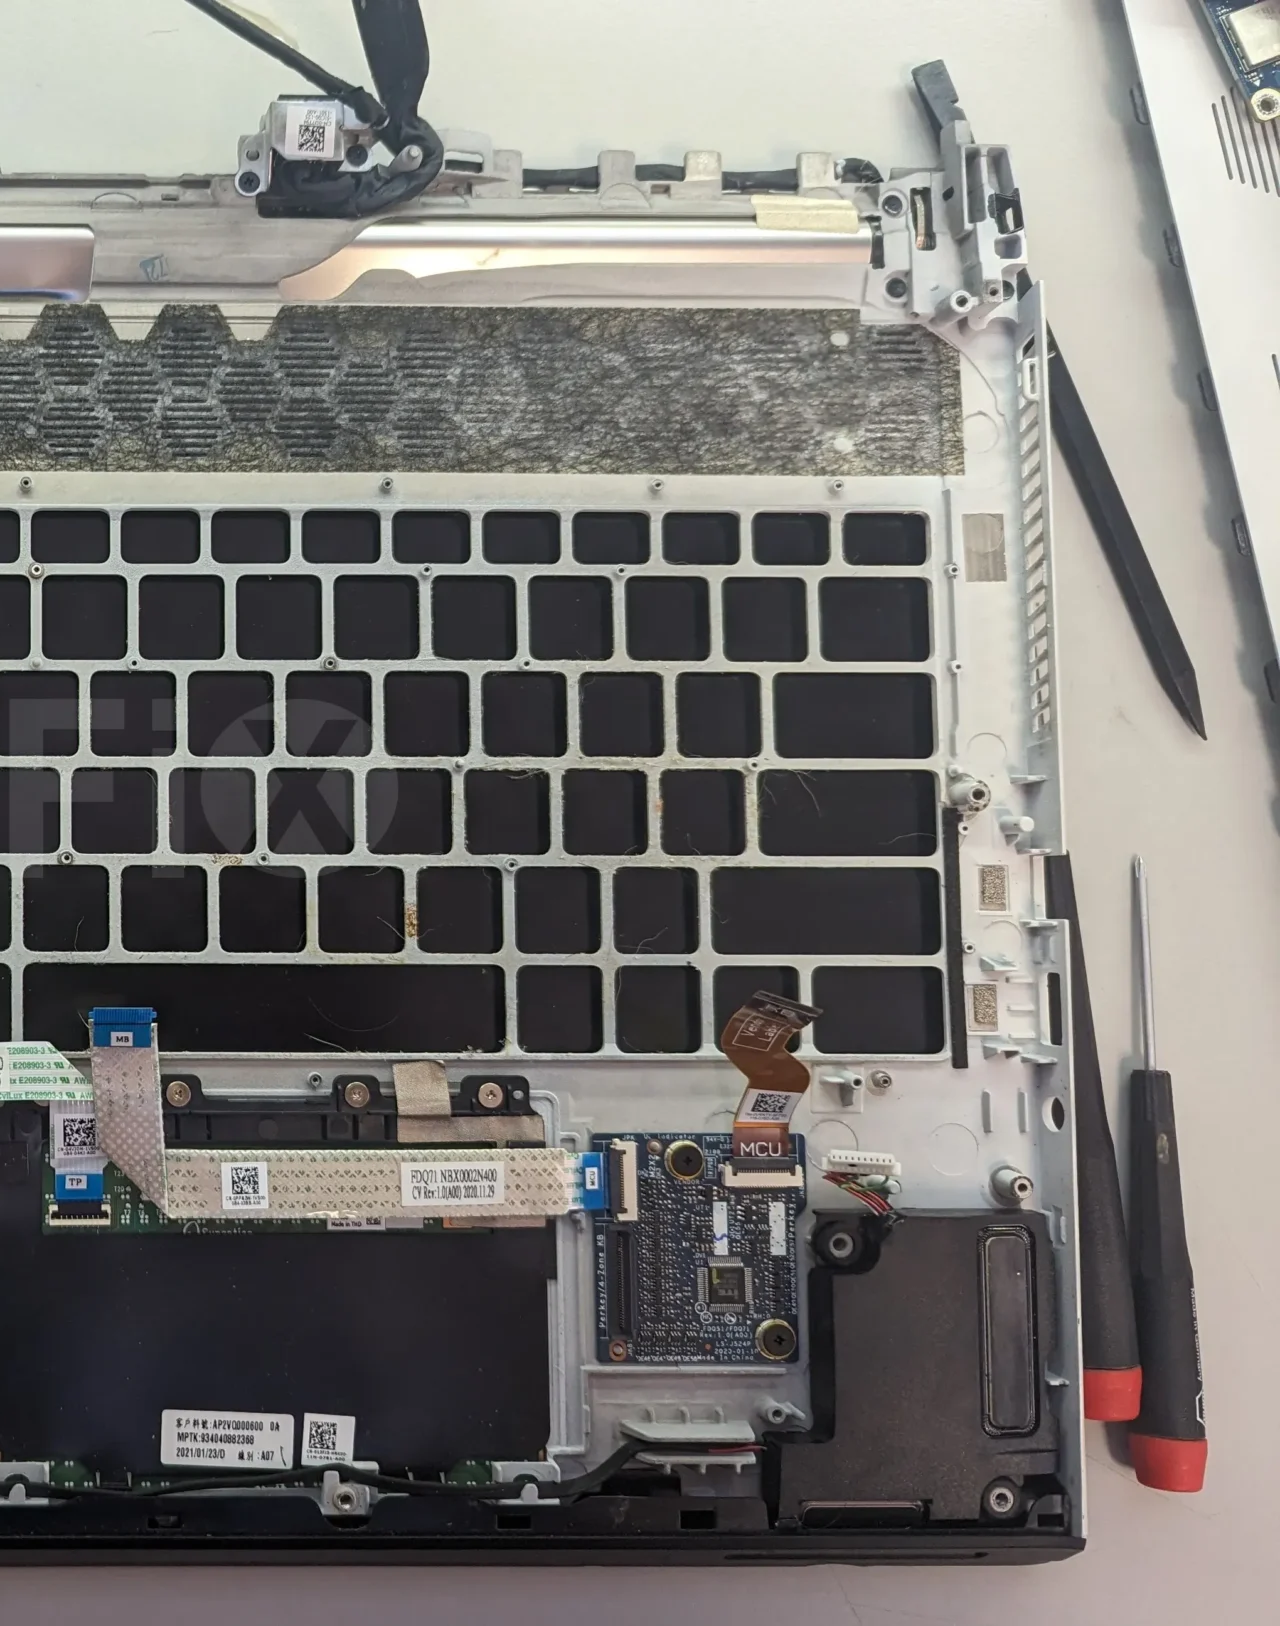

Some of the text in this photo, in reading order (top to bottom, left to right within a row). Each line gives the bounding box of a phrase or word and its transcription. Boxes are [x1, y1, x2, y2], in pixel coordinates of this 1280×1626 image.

[115, 1035, 130, 1043] MB
[739, 1141, 782, 1157] MCU
[68, 1177, 83, 1186] TP
[410, 1168, 498, 1185] FDQ71 NBX0002N400
[589, 1171, 597, 1187] MCU
[463, 1185, 495, 1199] 2020.11.29
[596, 1234, 605, 1246] KB
